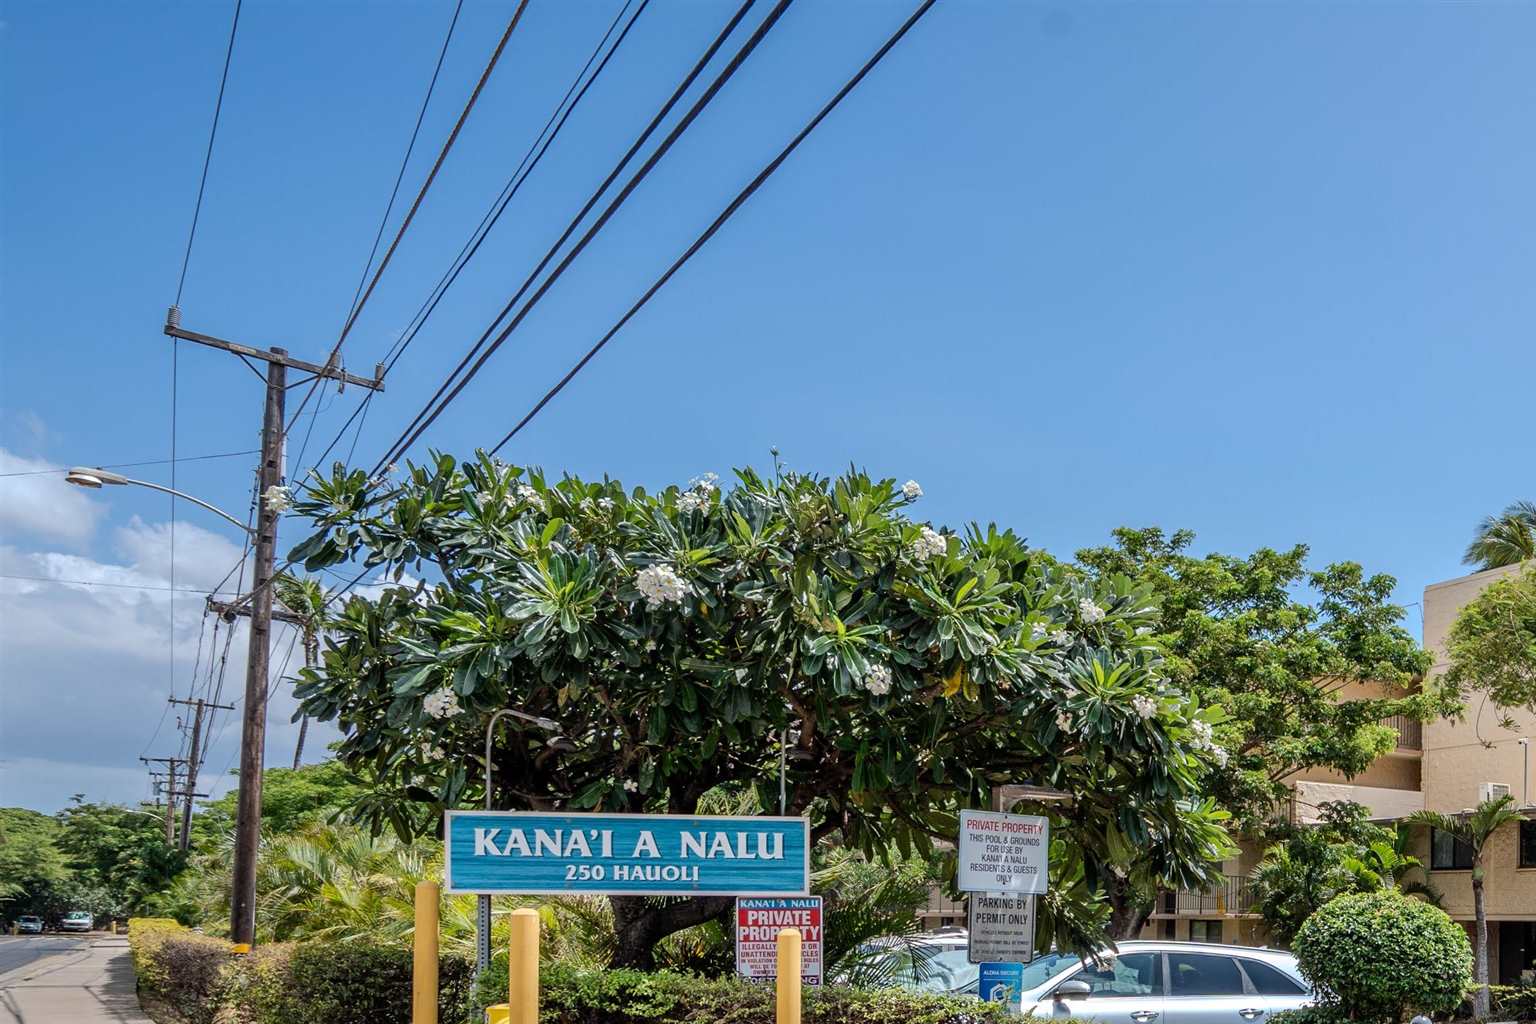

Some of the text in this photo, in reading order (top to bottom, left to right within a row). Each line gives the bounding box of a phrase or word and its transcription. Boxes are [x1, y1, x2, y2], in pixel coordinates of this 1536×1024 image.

[967, 819, 1043, 835] PRIVATE PROPERTY
[473, 827, 785, 861] KANA'I A NALU
[969, 833, 1040, 846] THIS POOL & GROUNDS
[986, 845, 1023, 855] FOR USE BY
[1004, 855, 1010, 863] A
[1010, 856, 1027, 864] NALU
[565, 864, 701, 882] 250 HAUOLI
[970, 863, 1038, 874] RESIDENTS & GUESTS
[996, 874, 1012, 883] ONLY
[779, 900, 786, 908] A
[791, 900, 819, 908] NALU
[978, 897, 1027, 910] PARKING BY
[748, 910, 811, 925] PRIVATE
[976, 913, 1028, 925] PERMIT ONLY
[740, 926, 820, 941] PROPTY
